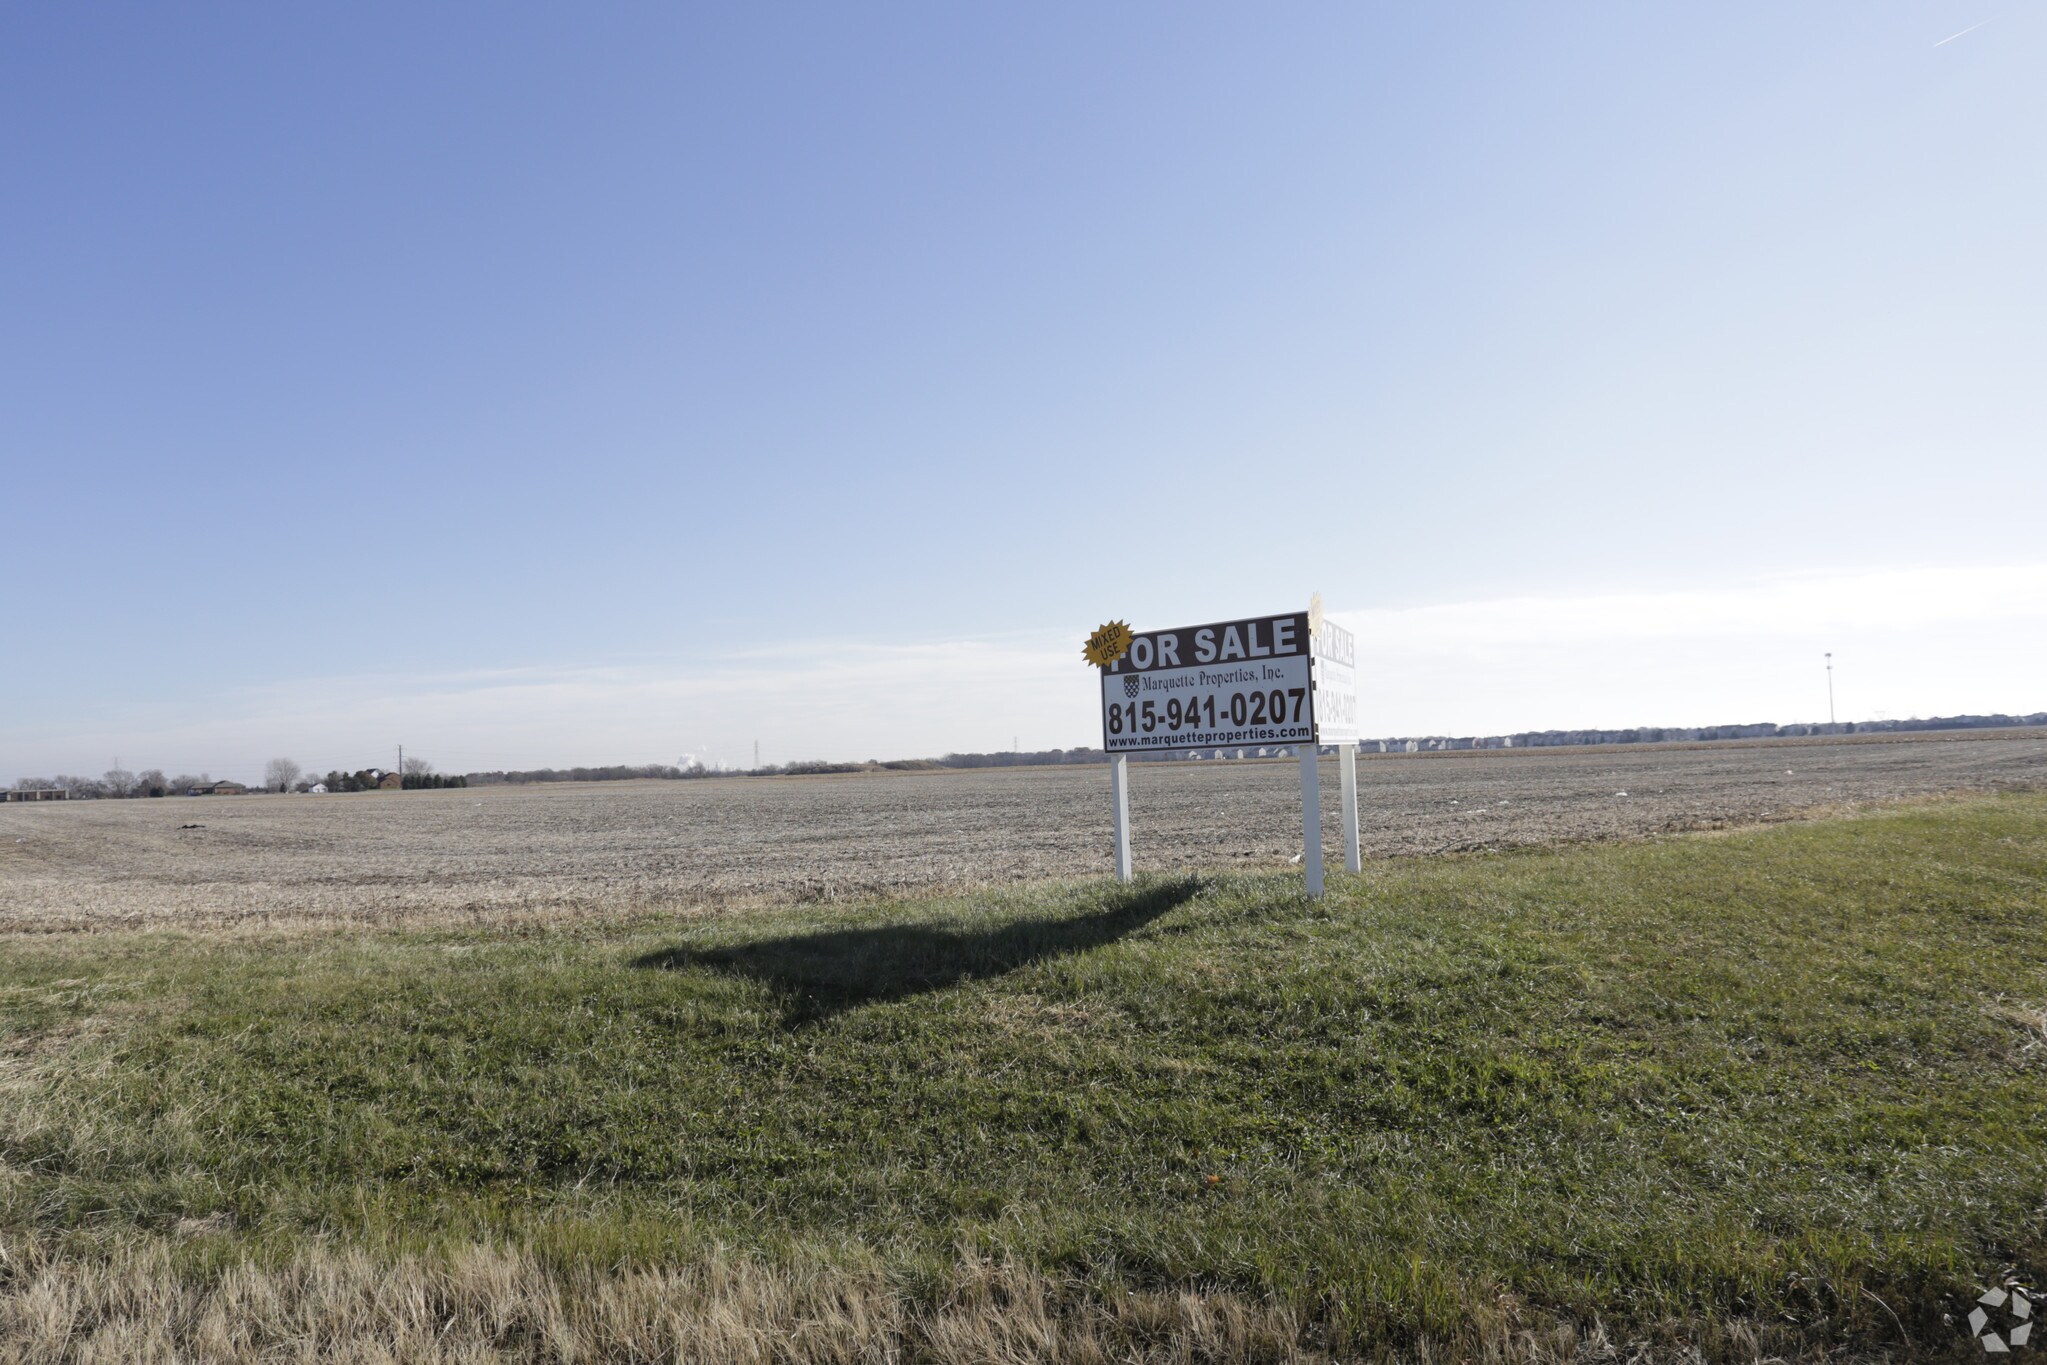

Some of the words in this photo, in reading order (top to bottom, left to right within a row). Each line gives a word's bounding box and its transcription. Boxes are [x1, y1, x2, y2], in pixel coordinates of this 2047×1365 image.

[1091, 626, 1121, 651] MIXED
[1100, 642, 1120, 661] USE
[1194, 618, 1297, 663] SALE
[1142, 675, 1194, 693] Marquette
[1199, 670, 1259, 688] Properties,
[1262, 664, 1284, 683] Inc.
[1108, 688, 1306, 735] 815-941-0207
[1108, 726, 1309, 748] www.marquetteproperties.com
